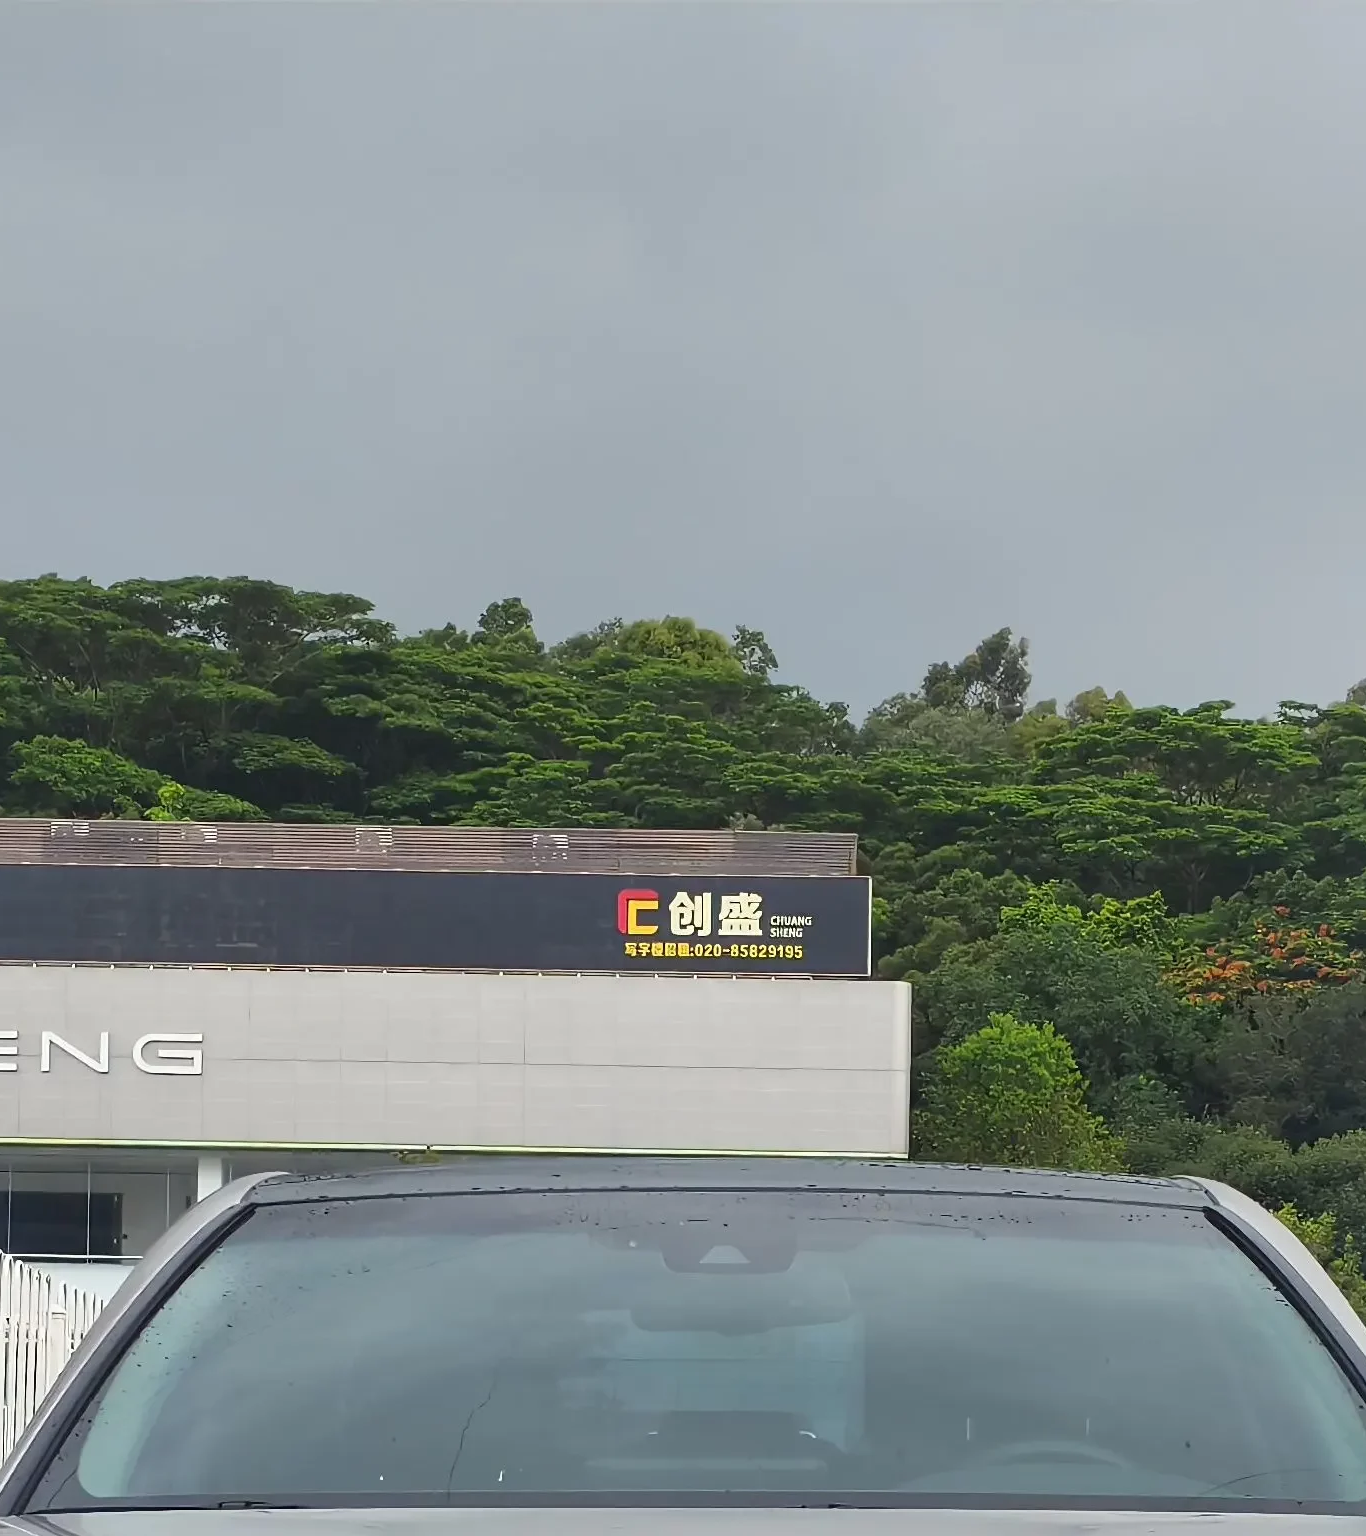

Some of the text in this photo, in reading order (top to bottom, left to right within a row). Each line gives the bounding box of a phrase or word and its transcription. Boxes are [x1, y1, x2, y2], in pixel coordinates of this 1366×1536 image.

[668, 891, 763, 937] 创盛
[769, 915, 812, 927] CHUANG
[769, 927, 803, 938] SHENG
